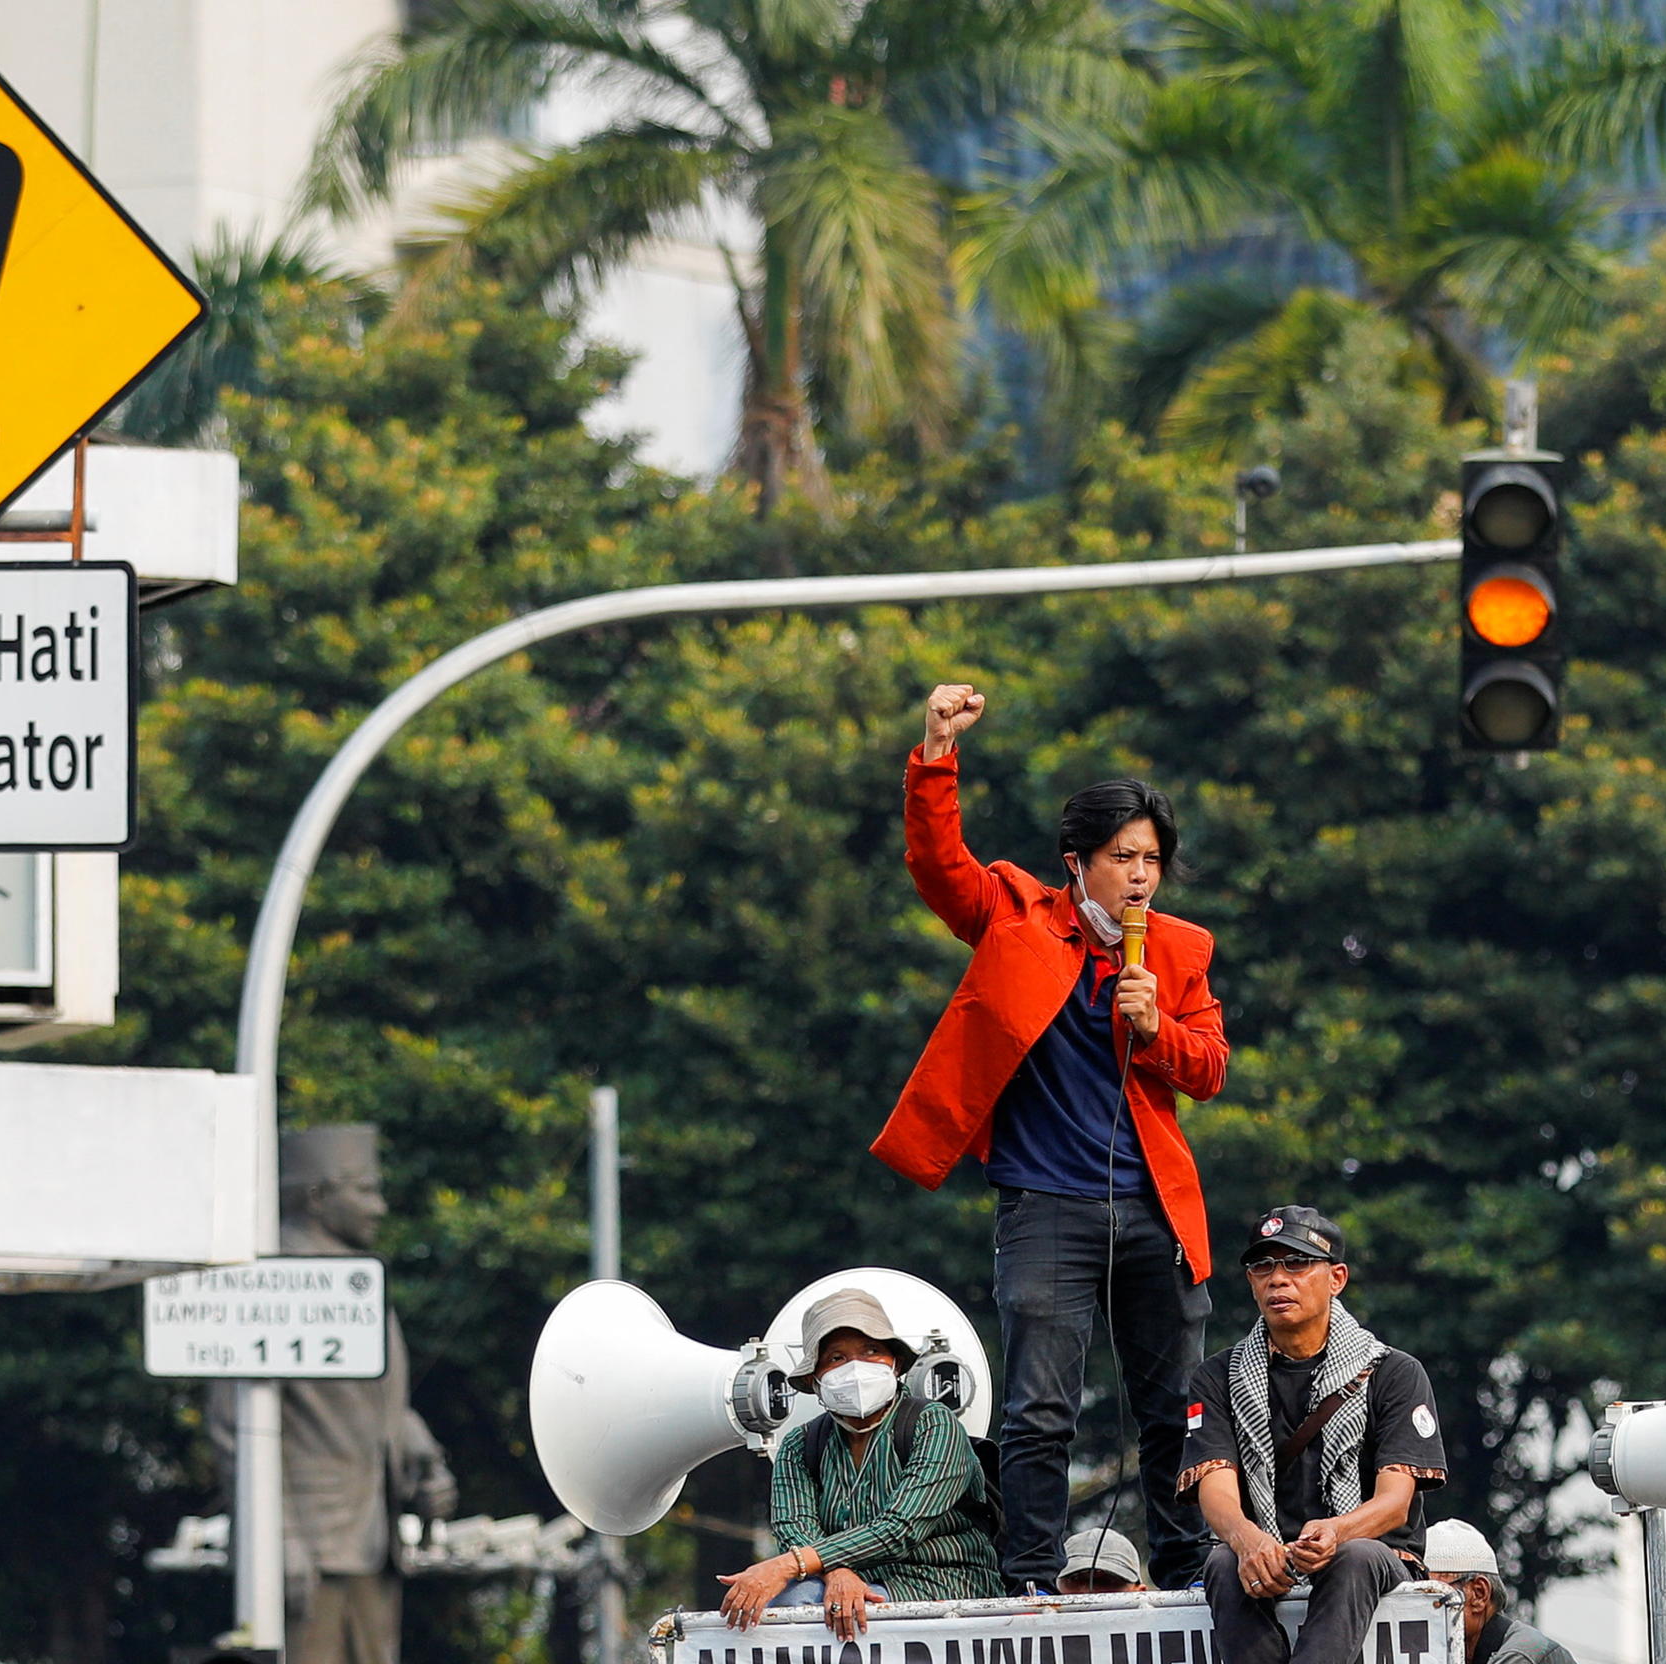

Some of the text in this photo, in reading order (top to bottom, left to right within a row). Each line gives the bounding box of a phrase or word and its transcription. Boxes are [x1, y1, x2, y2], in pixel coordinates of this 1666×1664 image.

[197, 1271, 334, 1293] PENGADUAN
[153, 1302, 378, 1325] LAMPU LALU LINTAS
